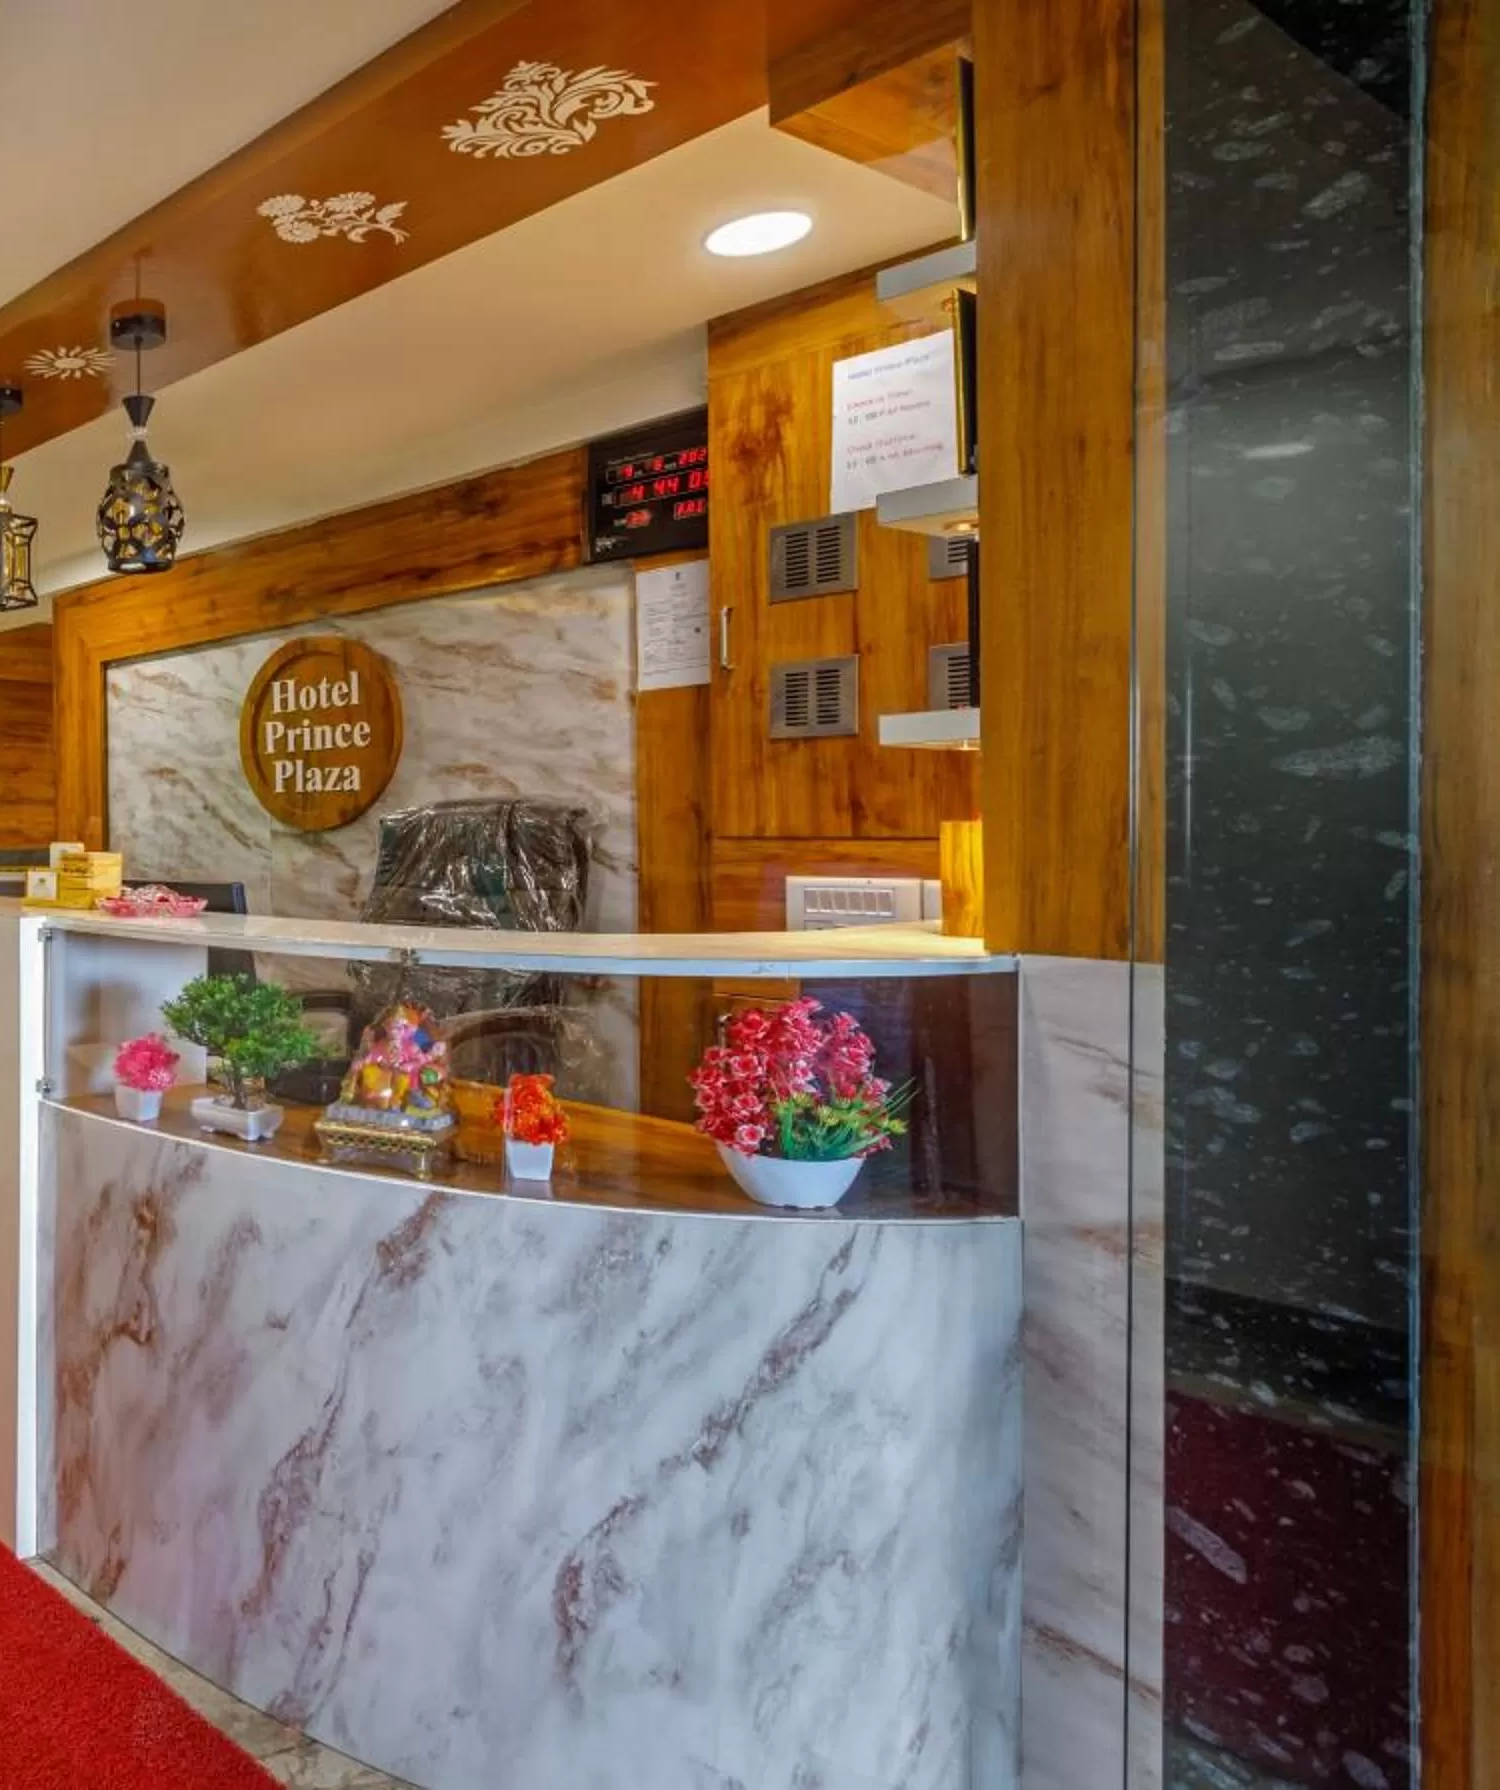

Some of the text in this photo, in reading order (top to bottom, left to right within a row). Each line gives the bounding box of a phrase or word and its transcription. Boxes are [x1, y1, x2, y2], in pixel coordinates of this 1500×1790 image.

[271, 670, 360, 714] Hotel
[264, 718, 372, 755] Prince
[272, 759, 361, 793] Plaza
